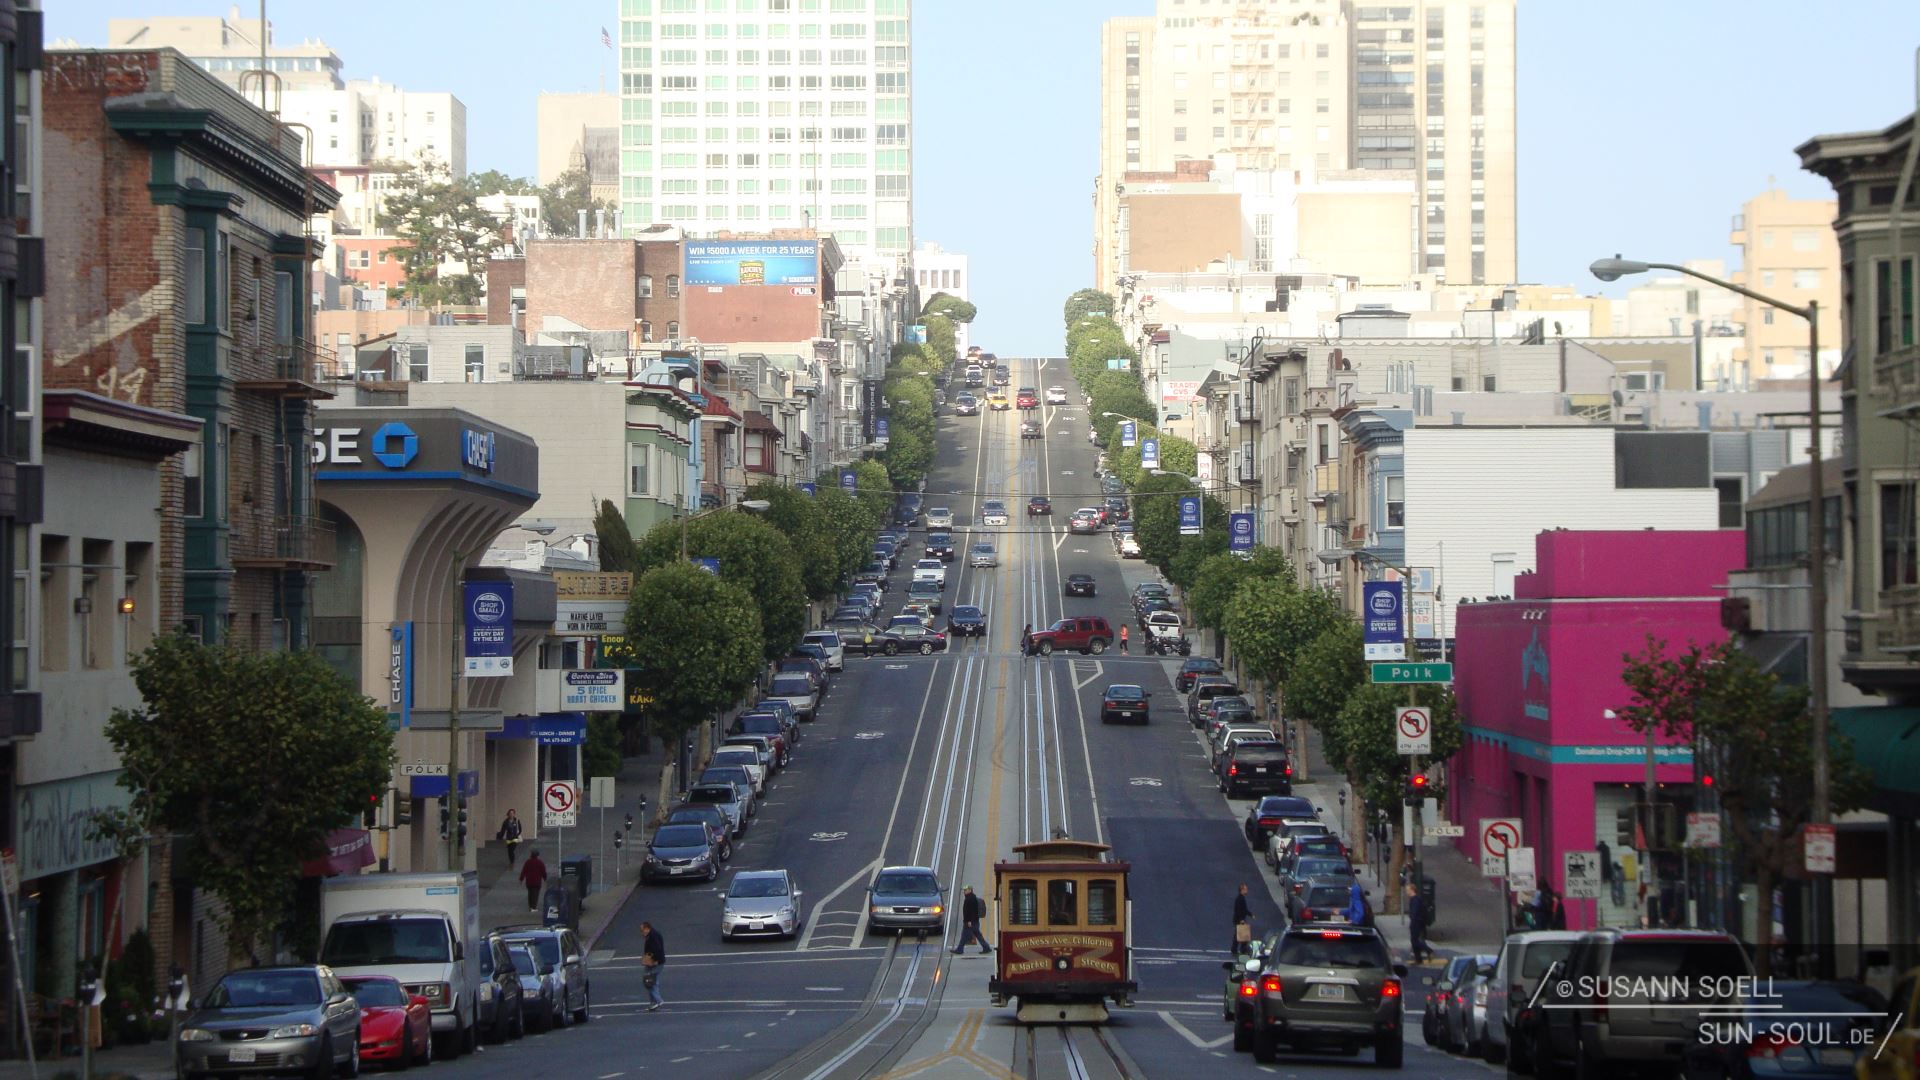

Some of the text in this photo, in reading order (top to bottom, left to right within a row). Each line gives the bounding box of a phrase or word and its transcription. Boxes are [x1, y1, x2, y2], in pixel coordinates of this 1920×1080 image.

[689, 247, 705, 255] WIN
[707, 247, 730, 255] $5000
[731, 247, 737, 255] A
[791, 246, 815, 254] YEARS
[740, 266, 763, 274] LUCKY
[467, 429, 487, 469] CHASE
[589, 612, 604, 620] LAYER
[567, 622, 579, 630] WORK
[580, 622, 585, 630] IN
[601, 634, 624, 643] Encor
[392, 644, 401, 703] CHASE
[1392, 668, 1432, 677] Polk
[577, 686, 607, 694] 5 SPICE
[589, 695, 617, 703] CHICKEN
[545, 811, 557, 819] 4PM
[562, 811, 574, 819] 6PM
[1568, 879, 1579, 887] DO
[1015, 940, 1029, 948] Van
[1029, 938, 1050, 946] Ness
[1072, 936, 1113, 947] California
[1019, 960, 1048, 970] Market
[1081, 958, 1115, 971] Streets
